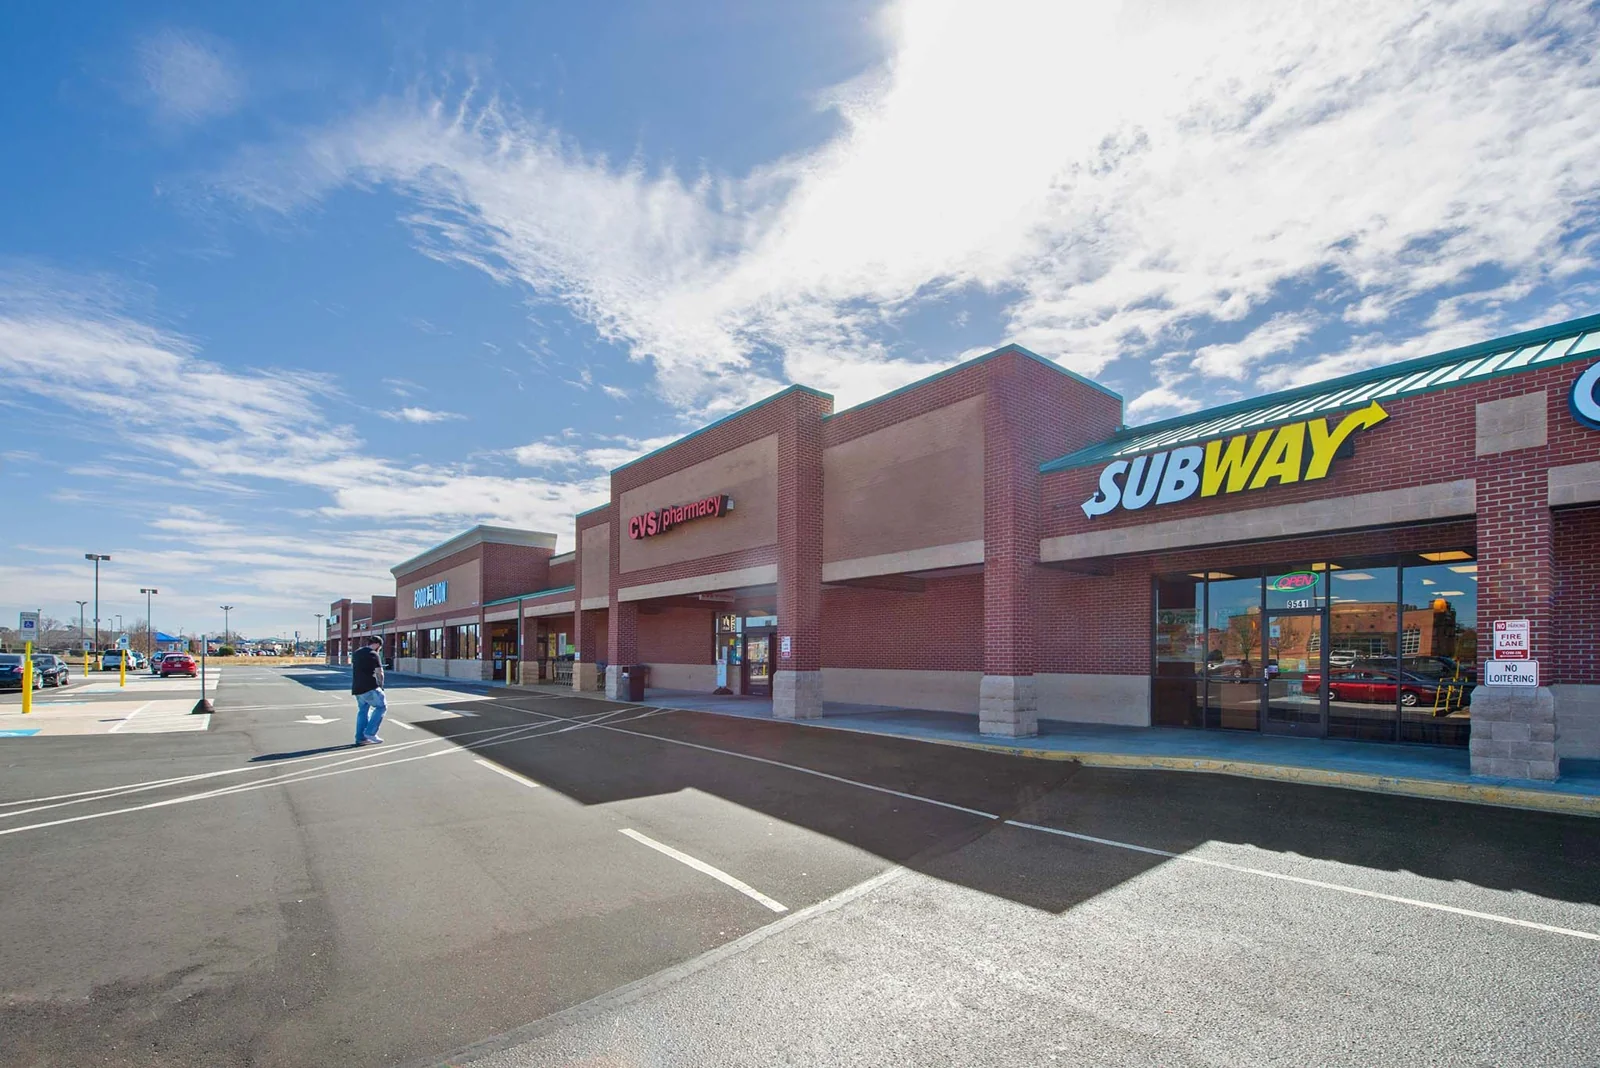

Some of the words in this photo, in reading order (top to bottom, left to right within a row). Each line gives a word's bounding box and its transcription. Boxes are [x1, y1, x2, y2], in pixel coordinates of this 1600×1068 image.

[1081, 400, 1389, 519] SUBWAY
[1278, 574, 1313, 588] OPEN
[1287, 600, 1308, 609] 9541
[1496, 622, 1506, 630] NO
[1505, 664, 1518, 673] NO
[1489, 674, 1534, 683] LOITERING
